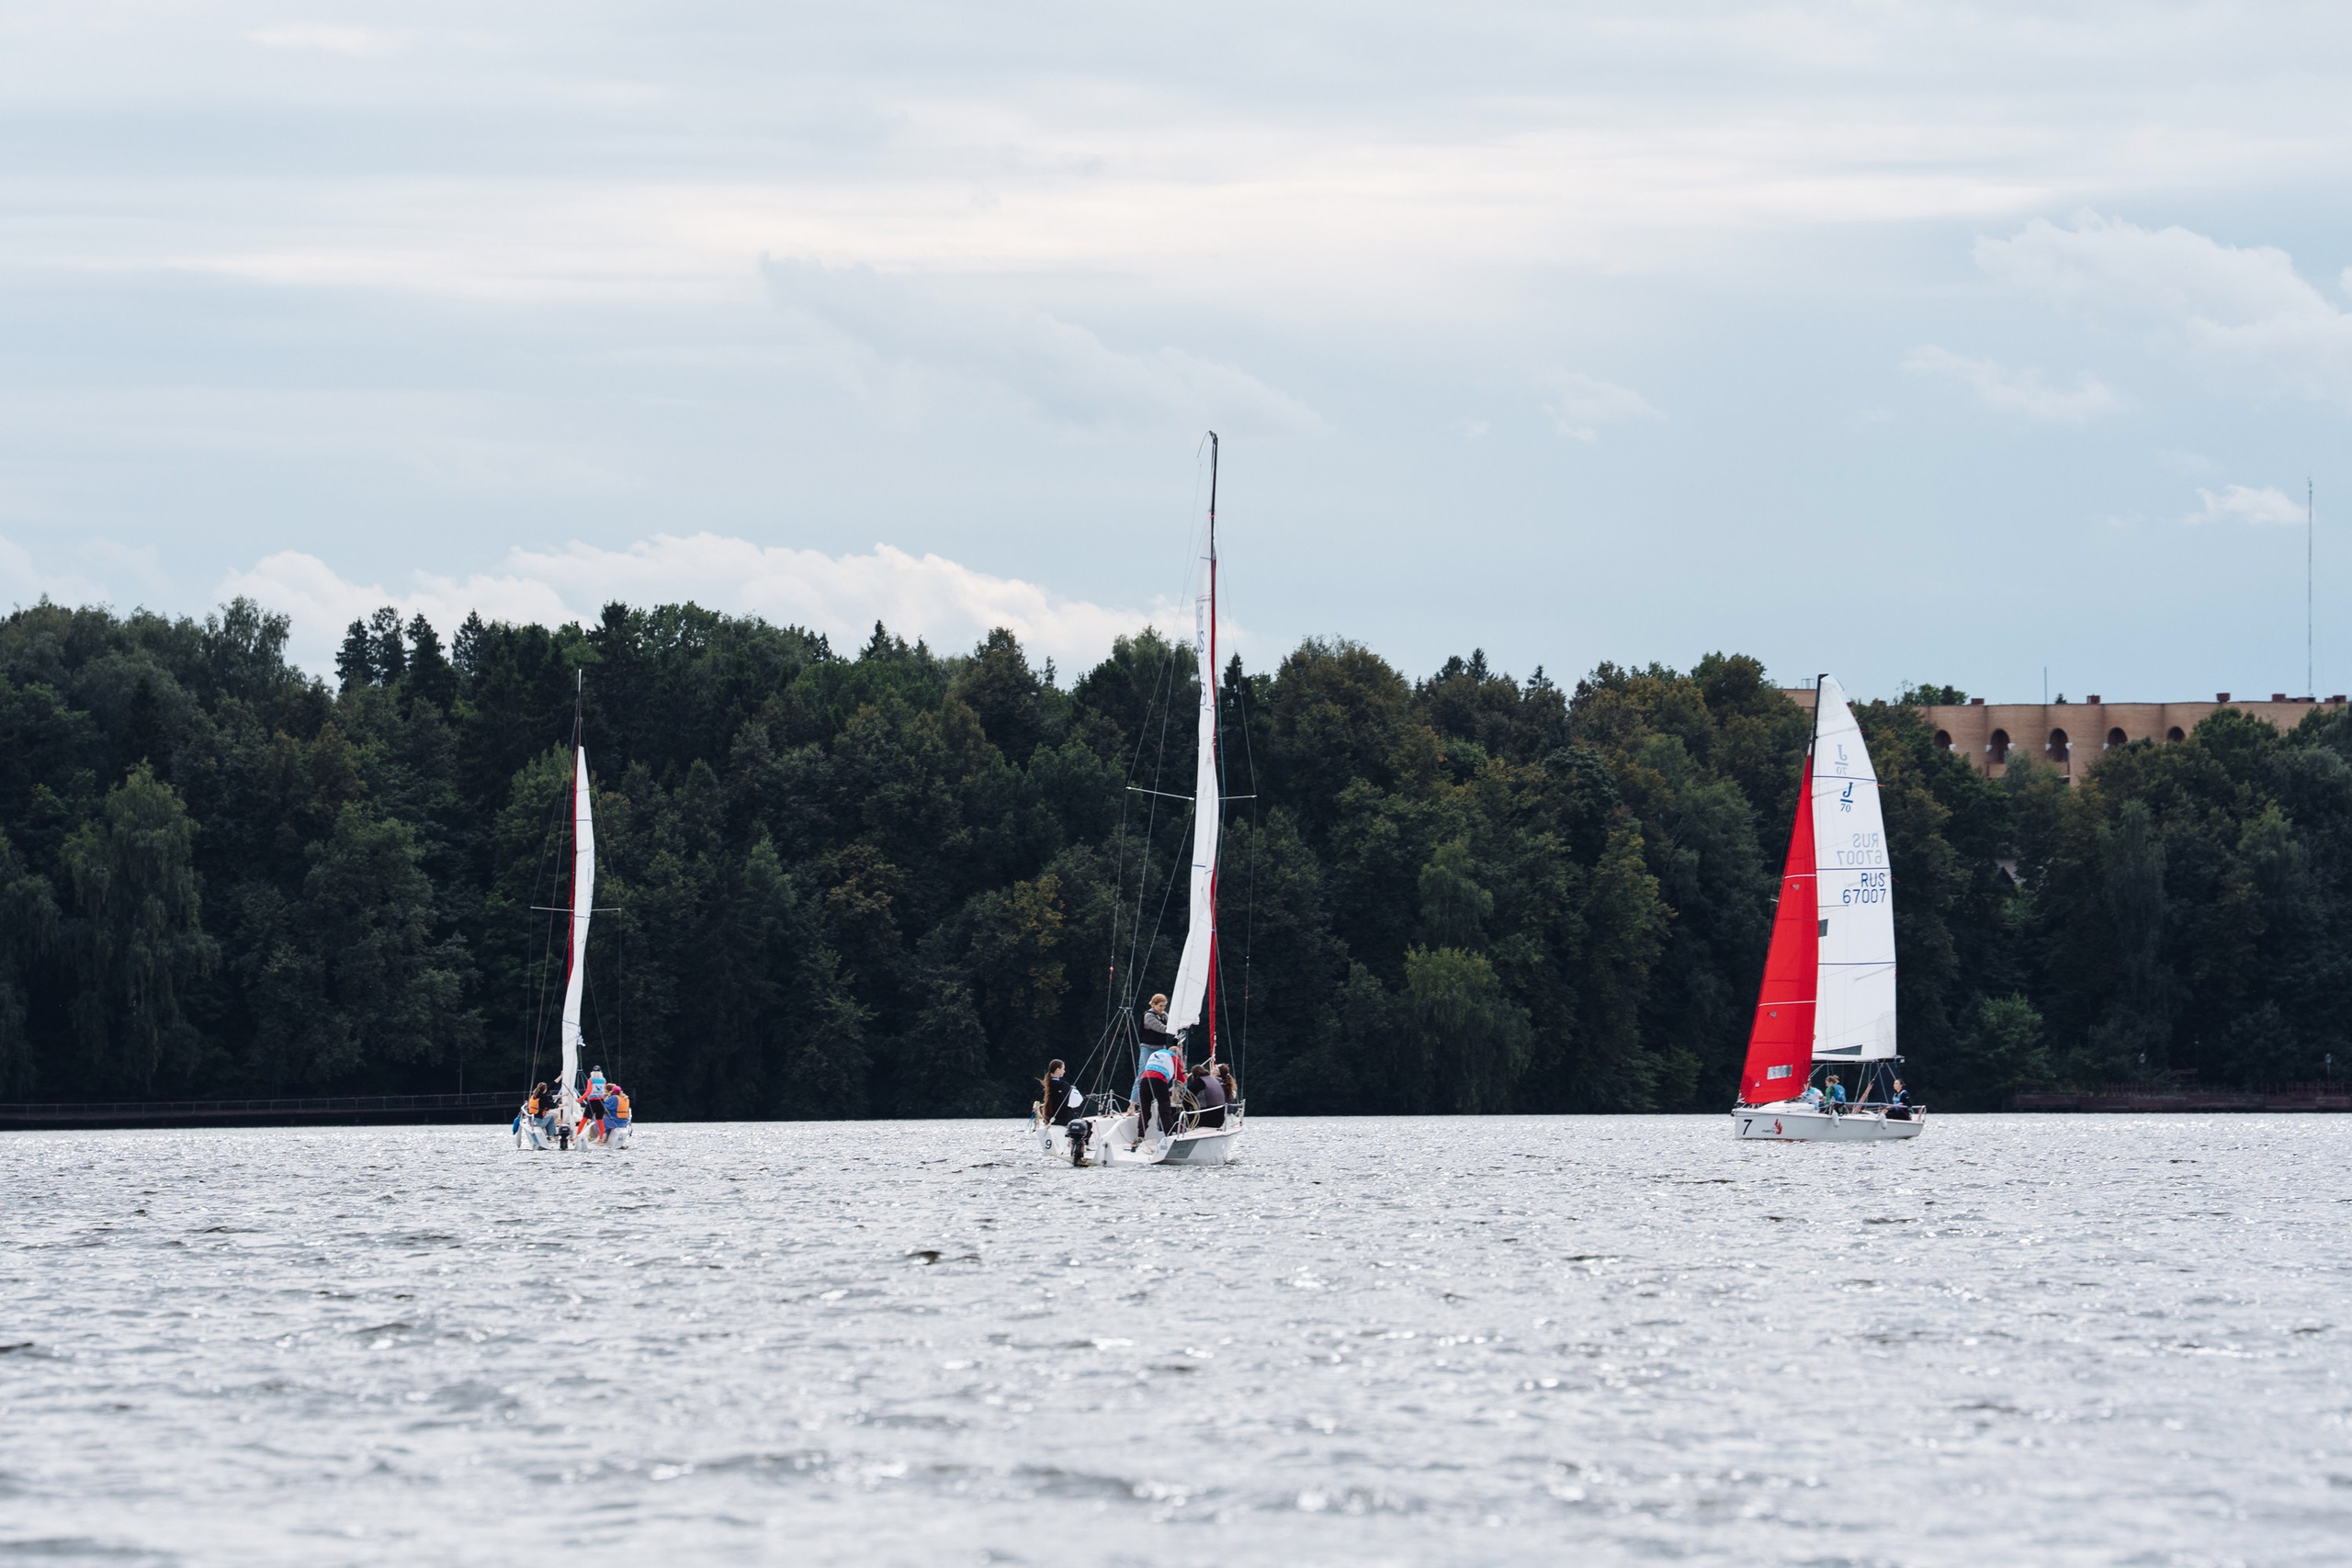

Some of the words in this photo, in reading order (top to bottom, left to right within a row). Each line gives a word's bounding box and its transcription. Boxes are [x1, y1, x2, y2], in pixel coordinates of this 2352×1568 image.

[1840, 804, 1851, 813] 70
[1861, 873, 1885, 887] RUS
[1843, 889, 1886, 904] 67007
[1743, 1119, 1753, 1135] 7
[1045, 1139, 1053, 1150] 9
